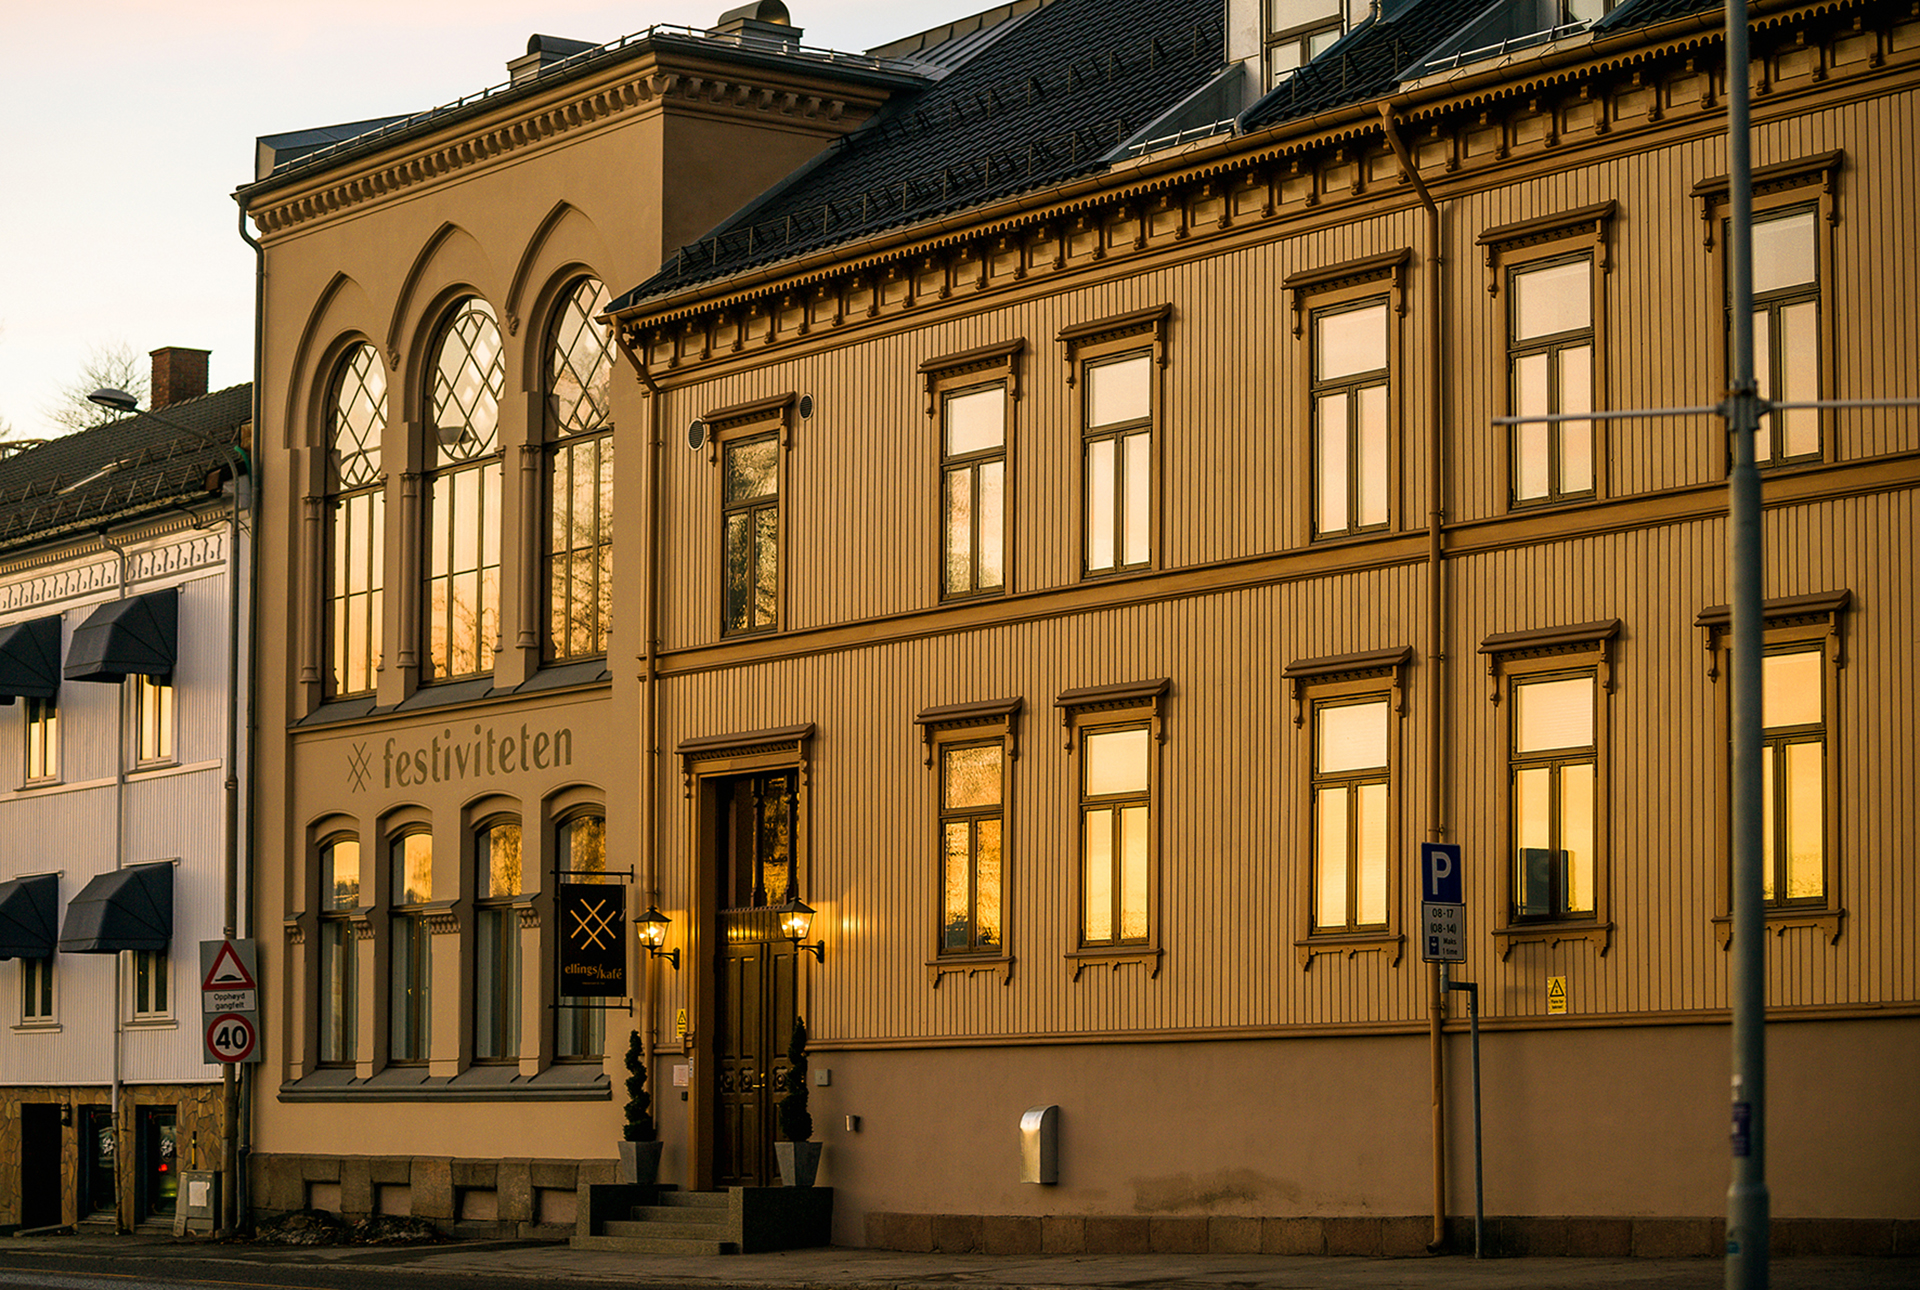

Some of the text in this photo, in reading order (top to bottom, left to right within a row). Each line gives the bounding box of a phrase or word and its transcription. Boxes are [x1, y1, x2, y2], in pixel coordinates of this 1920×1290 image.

[383, 722, 572, 789] festiviteten
[1431, 851, 1452, 895] P
[1432, 908, 1454, 919] 08-17
[1430, 922, 1456, 935] (08-14)
[213, 992, 245, 1001] Opphøyd
[215, 1001, 245, 1010] gangfelt
[215, 1025, 247, 1049] 40
